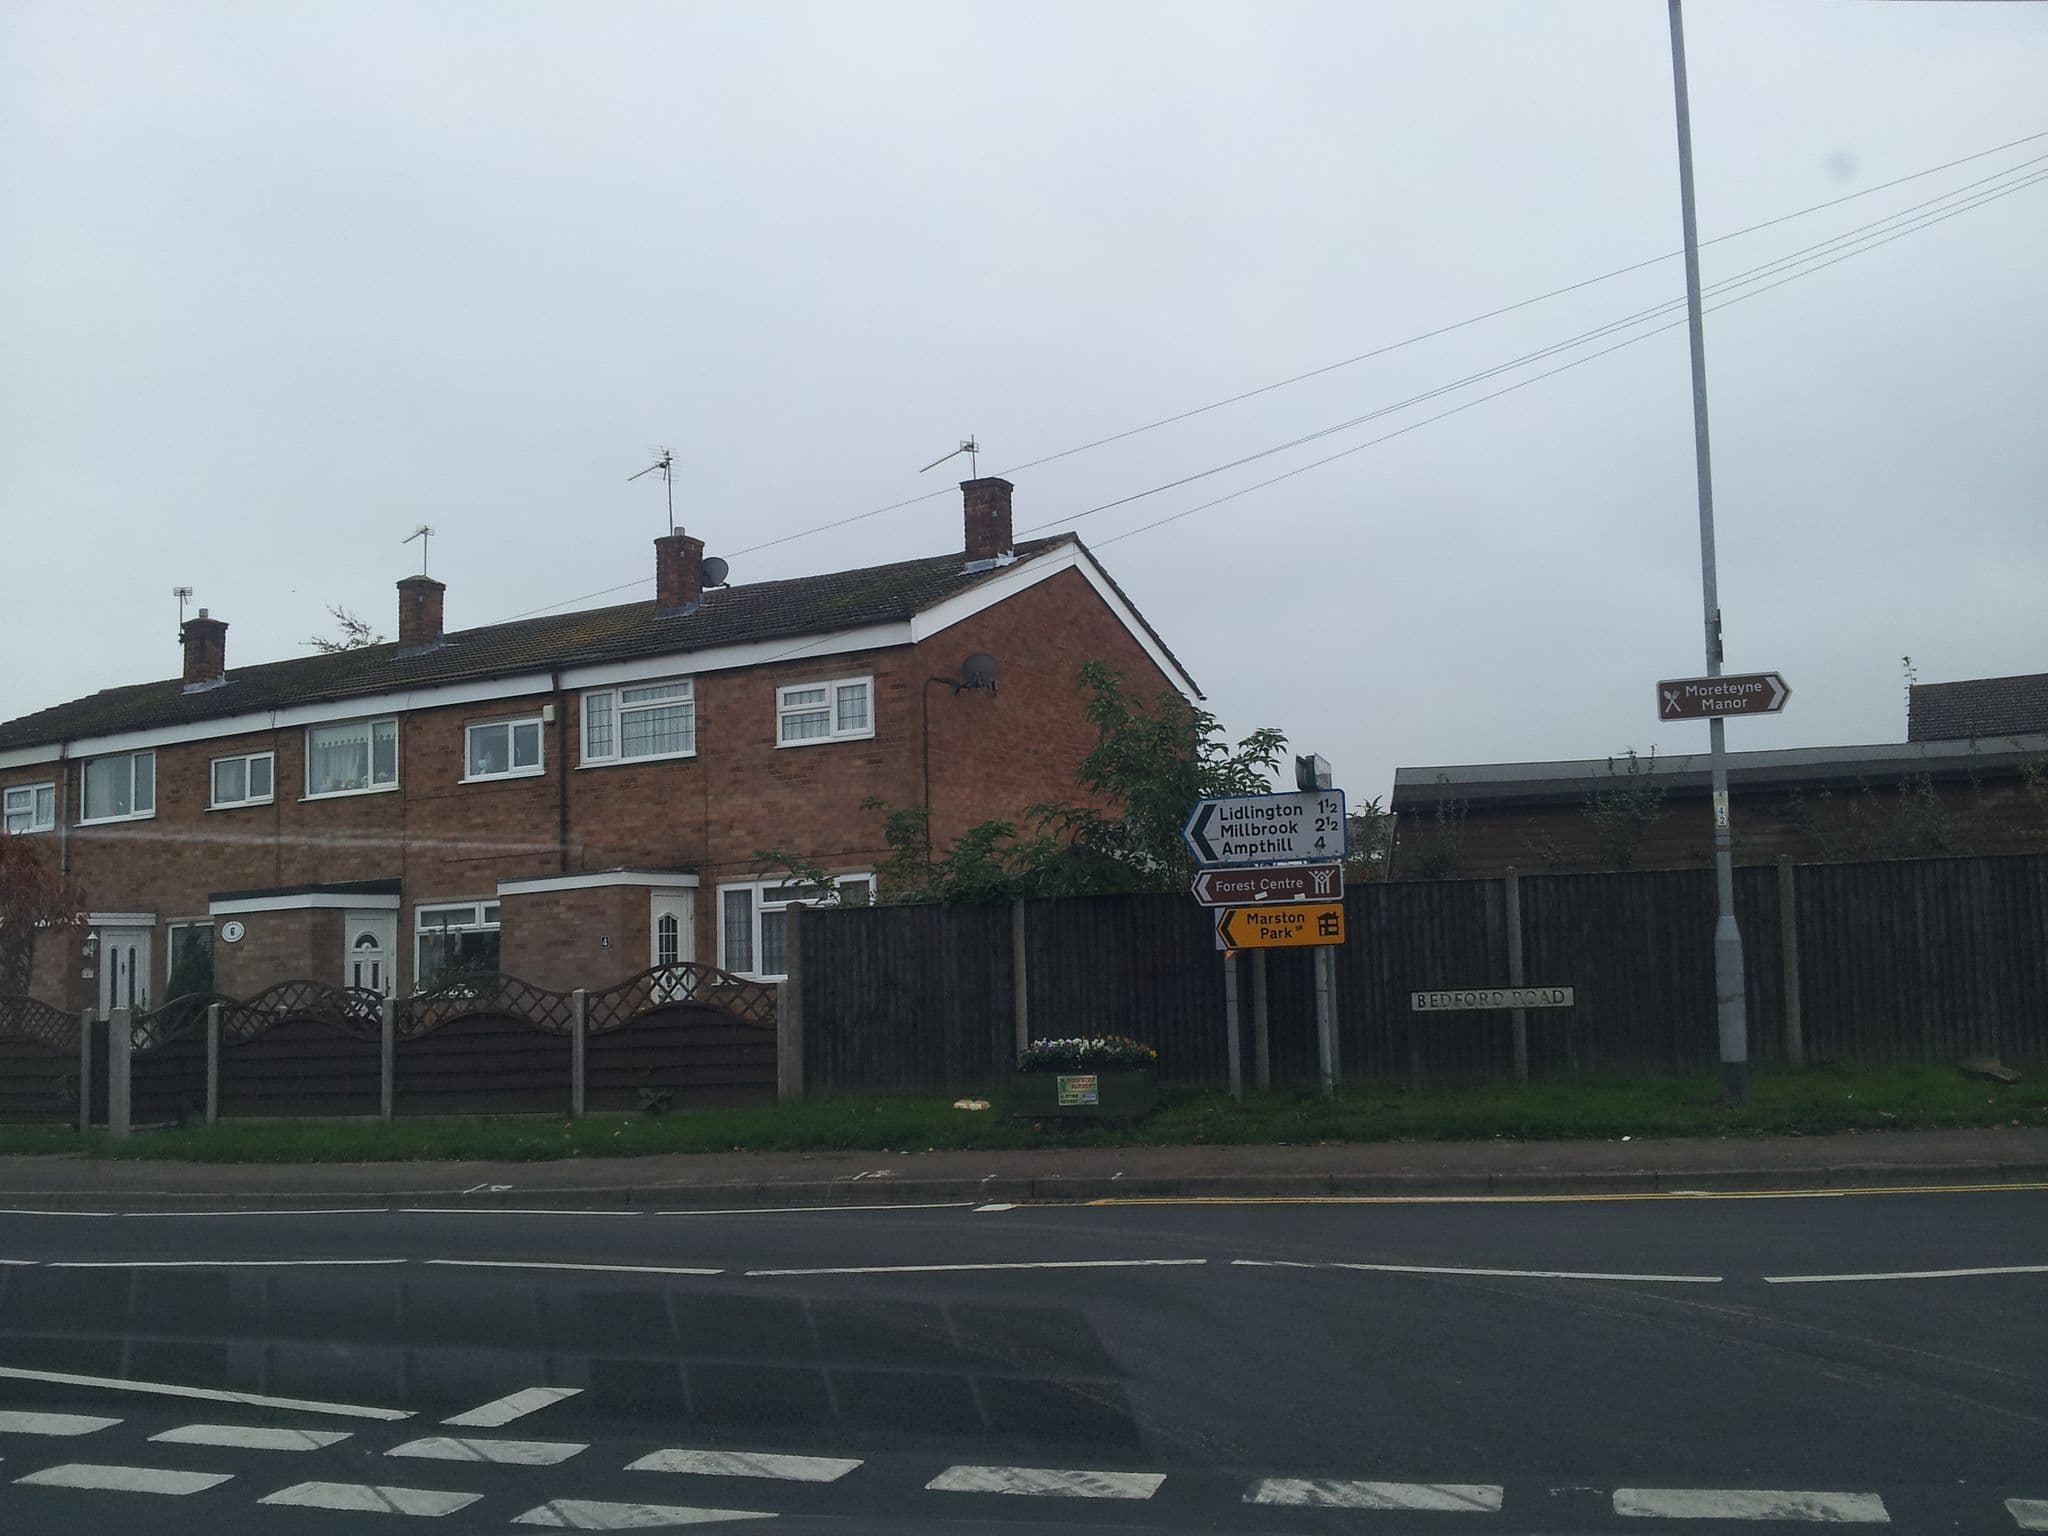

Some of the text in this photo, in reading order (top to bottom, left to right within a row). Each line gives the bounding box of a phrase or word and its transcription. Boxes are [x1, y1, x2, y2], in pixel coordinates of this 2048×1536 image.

[1685, 682, 1763, 697] Moreteyne
[1702, 698, 1748, 711] Manor
[1219, 803, 1303, 821] Lidlington
[1220, 821, 1298, 838] Millbrook
[1222, 836, 1326, 856] Ampthill 4
[1216, 878, 1304, 892] Forest Centre
[1247, 910, 1305, 924] Marston
[1260, 926, 1292, 939] Park
[1417, 989, 1565, 1009] BEDFORD ROAD
